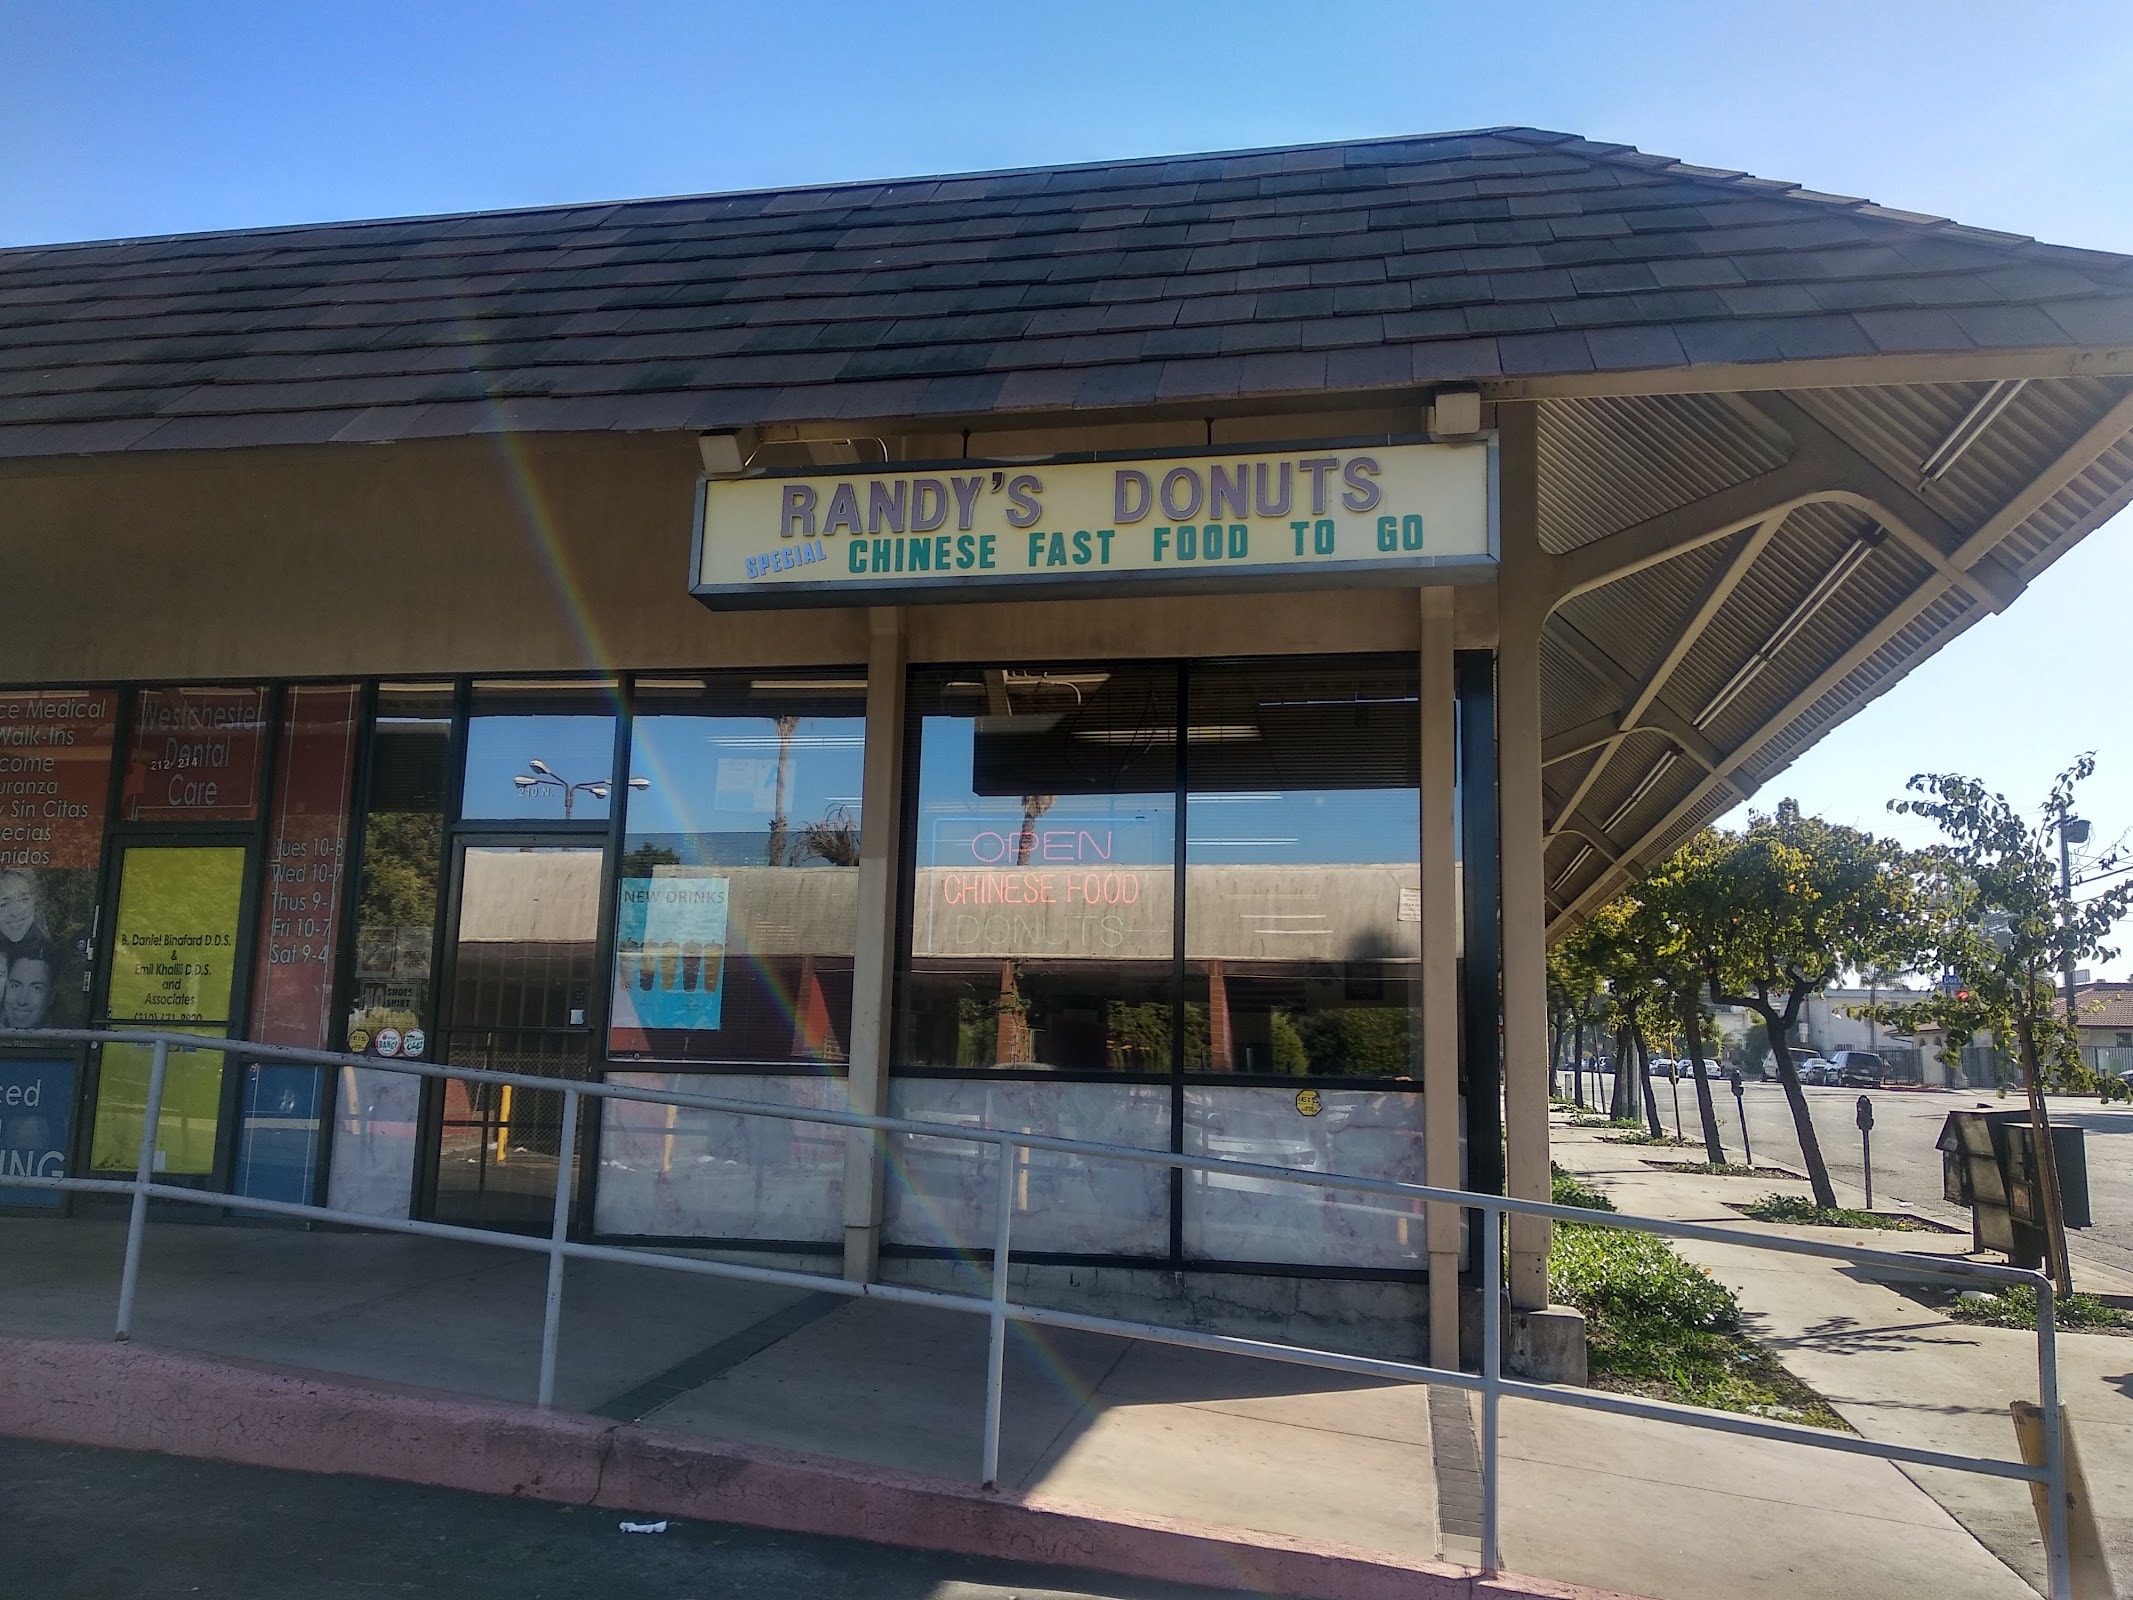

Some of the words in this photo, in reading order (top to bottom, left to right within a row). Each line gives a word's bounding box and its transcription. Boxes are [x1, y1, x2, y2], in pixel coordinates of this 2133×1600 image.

[781, 472, 1043, 537] RANDY'S
[1114, 457, 1381, 524] DONUTS
[745, 539, 827, 579] SPECIAL
[849, 534, 996, 573] CHINESE
[1028, 530, 1115, 567] FAST
[1153, 524, 1248, 562] FOOD
[1290, 519, 1334, 556] TO
[1377, 514, 1423, 552] GO
[26, 699, 106, 720] Medical
[143, 698, 263, 731] Westchester
[165, 736, 231, 768] Dental
[0, 757, 55, 773] come
[168, 774, 218, 806] Care
[10, 800, 36, 818] Sin
[43, 799, 89, 818] Citas
[275, 838, 307, 857] Tues
[971, 831, 1112, 863] OPEN
[272, 863, 306, 882] Wed
[312, 863, 343, 883] 10-7
[624, 890, 660, 904] NEW
[666, 890, 725, 904] DRINKS
[944, 873, 1057, 904] CHINESE
[1067, 873, 1139, 904] FOOD
[272, 891, 306, 911] Thus
[272, 918, 291, 937] Fri
[297, 917, 331, 937] 10-7
[956, 913, 1124, 948] DONUTS
[132, 934, 161, 946] Daniel
[204, 934, 232, 946] D.D.S.
[170, 950, 178, 961] &
[270, 944, 297, 963] Sat
[302, 944, 329, 964] 9-4
[134, 964, 154, 976] Emil
[185, 964, 211, 976] D.D.S.
[162, 979, 181, 990] and
[387, 988, 412, 996] SHOES
[144, 993, 195, 1005] Associates
[386, 999, 410, 1008] SHIRT
